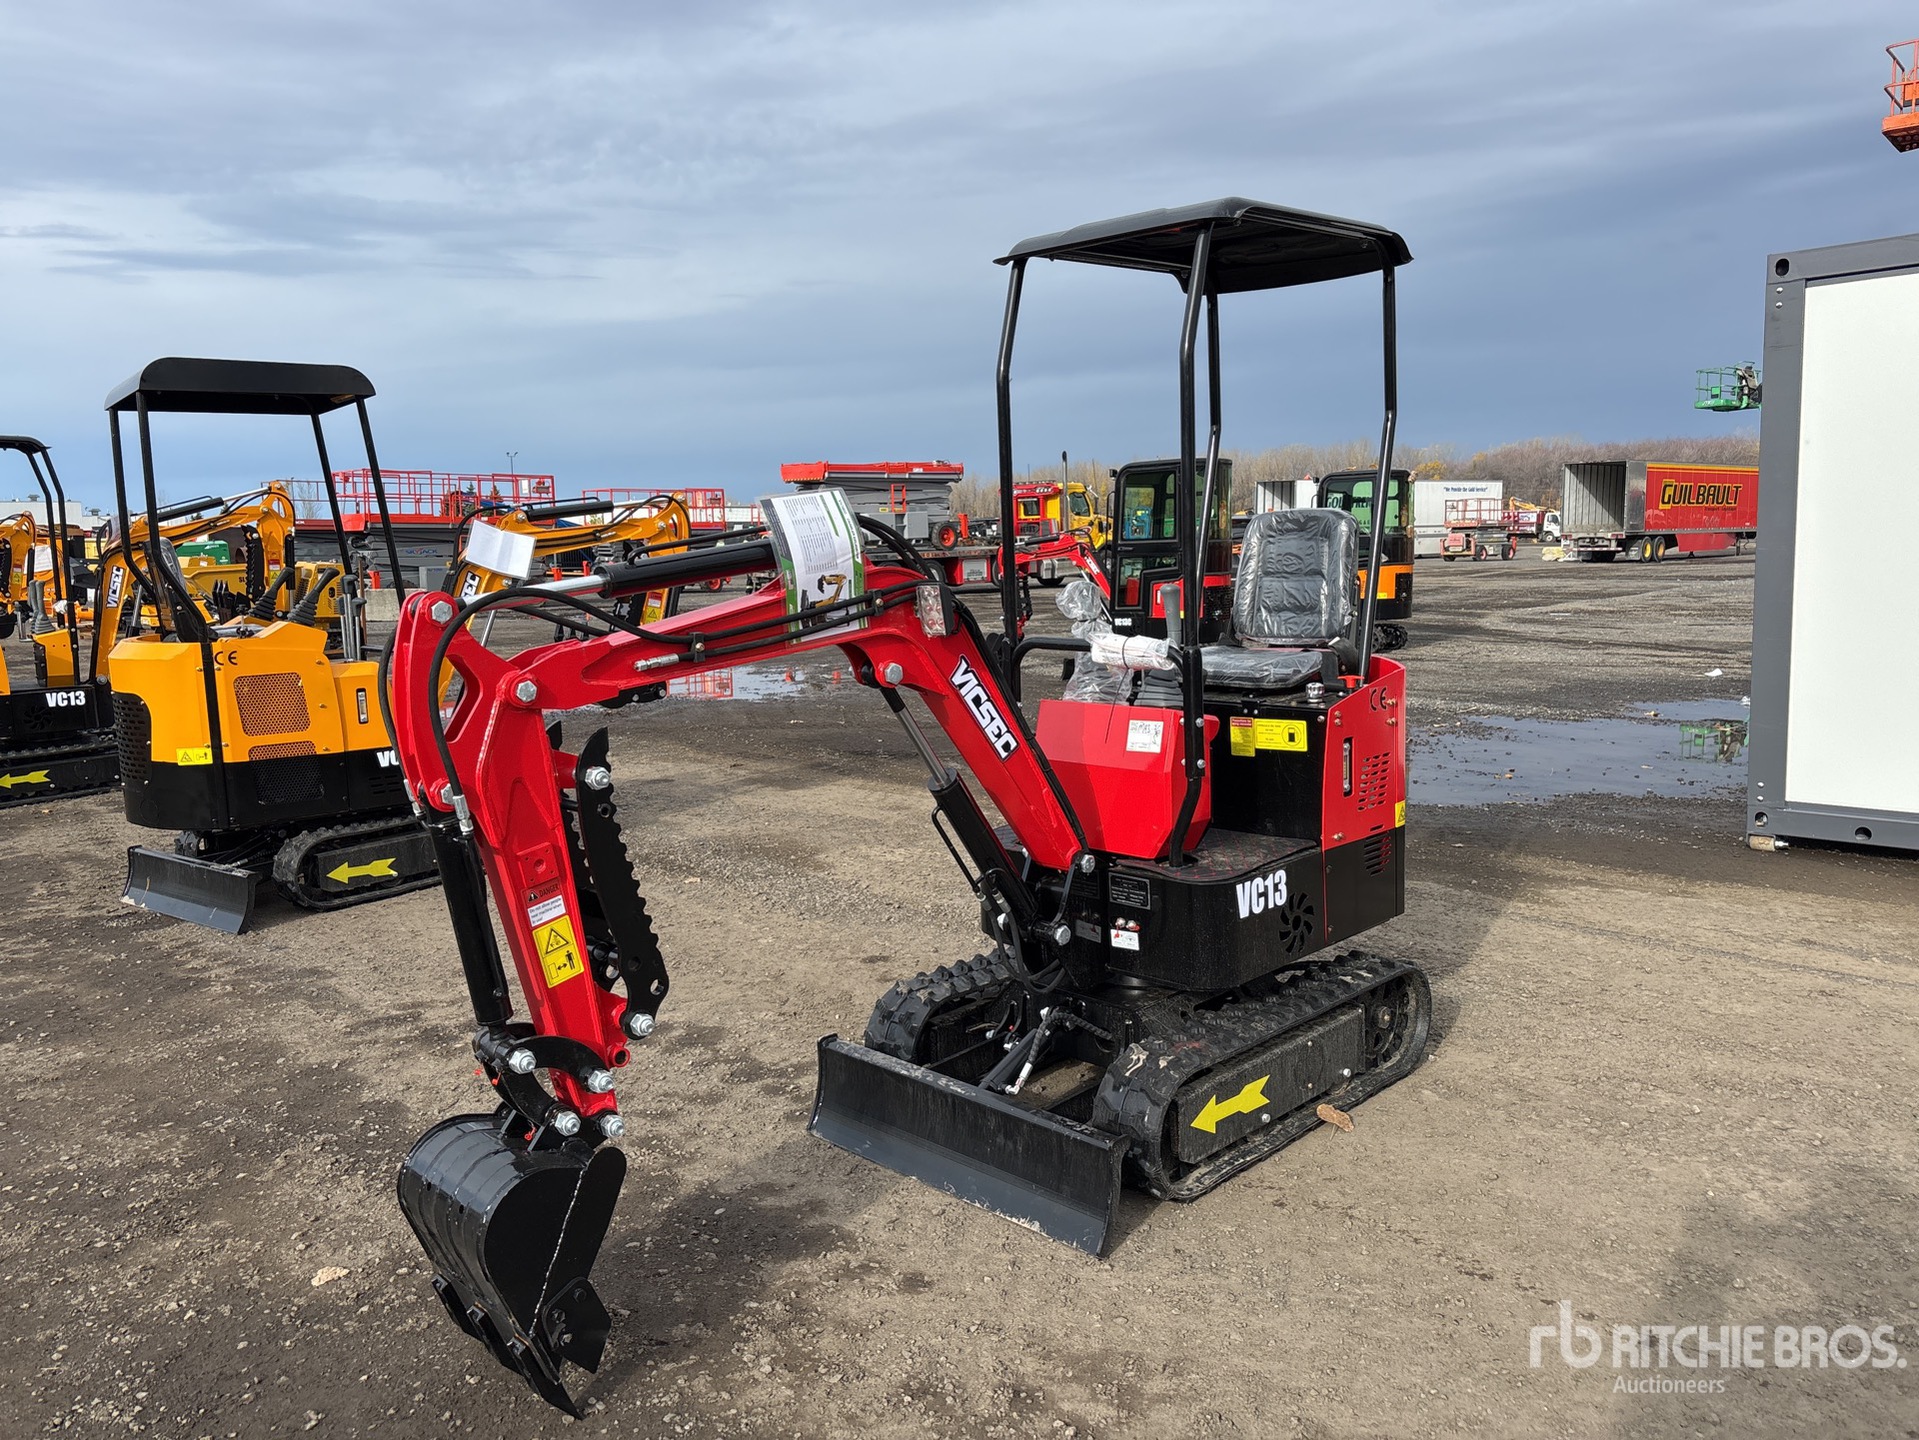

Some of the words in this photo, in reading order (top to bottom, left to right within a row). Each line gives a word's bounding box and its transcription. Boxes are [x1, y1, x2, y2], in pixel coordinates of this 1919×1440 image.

[1660, 482, 1743, 507] GUILBAULT
[106, 565, 124, 608] VICSEC
[45, 690, 86, 708] VC13
[949, 656, 1020, 761] VICSEC
[1235, 869, 1288, 919] VC13
